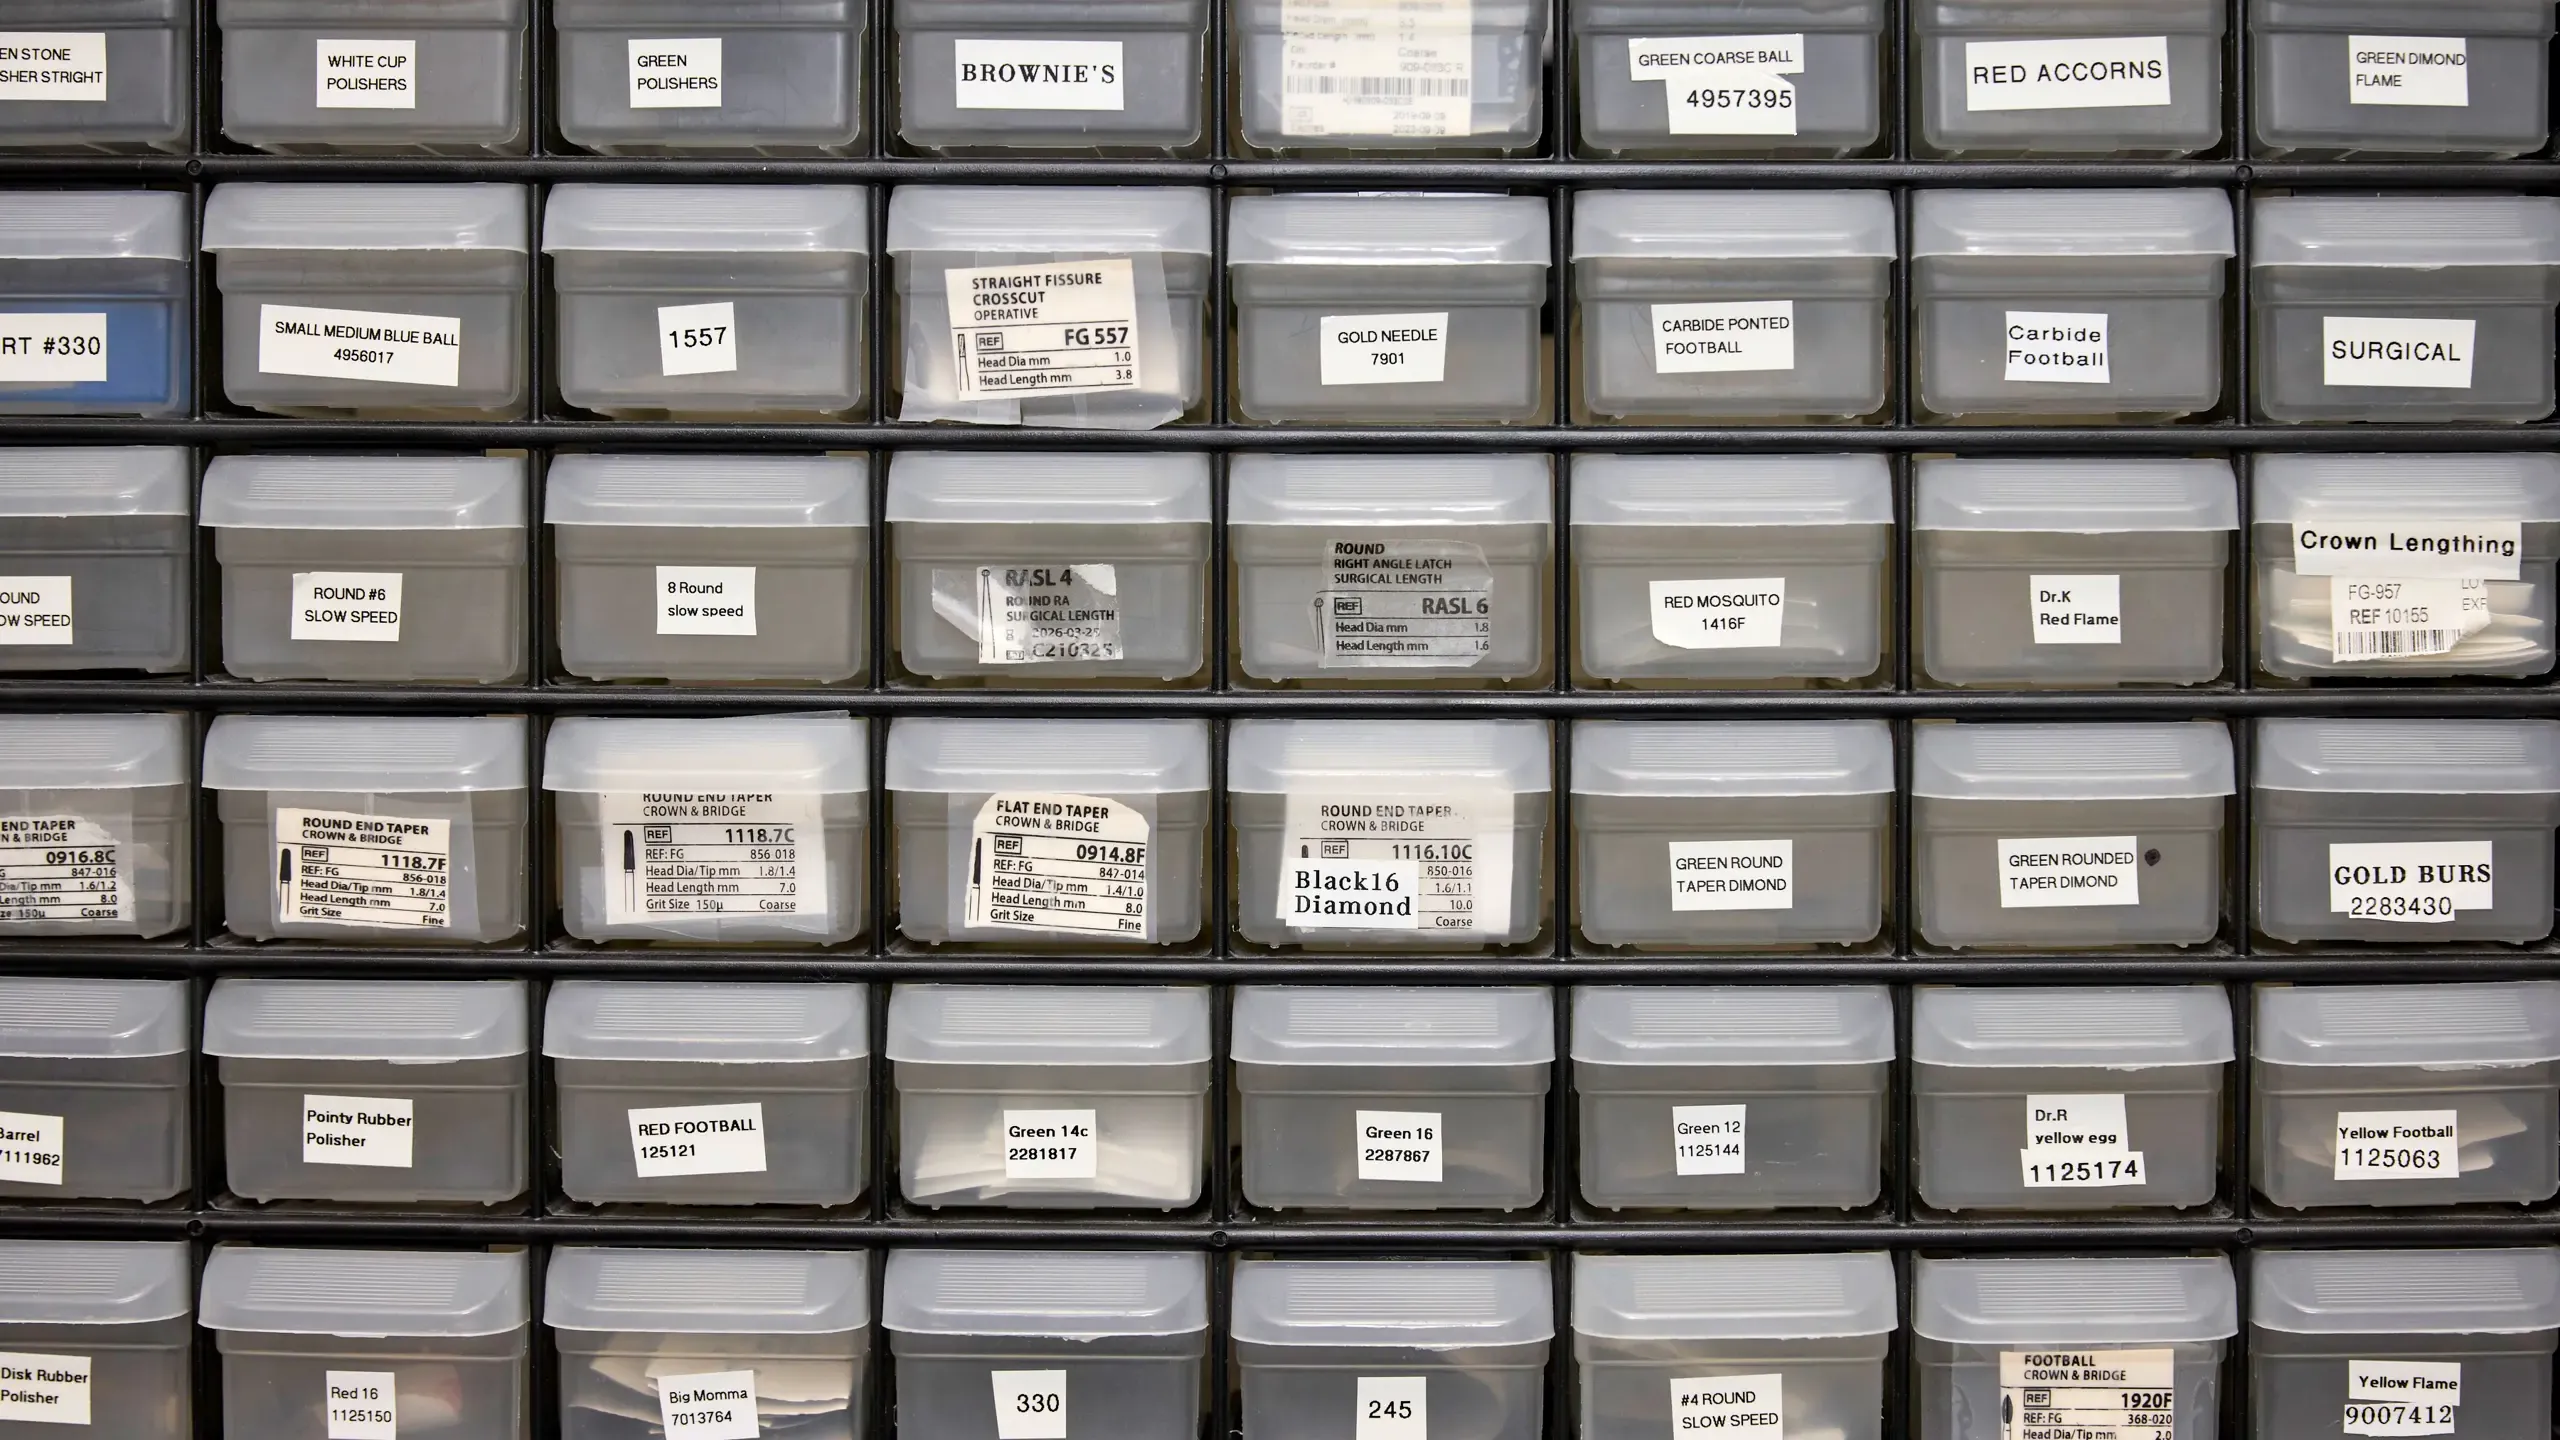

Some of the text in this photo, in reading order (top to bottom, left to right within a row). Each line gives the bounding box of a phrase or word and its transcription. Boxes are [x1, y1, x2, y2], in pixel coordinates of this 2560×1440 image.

[0, 48, 70, 60] EN STONE
[638, 55, 686, 67] GREEN
[1639, 51, 1793, 66] GREEN COARSE BALL
[2357, 52, 2466, 66] GREEN DIMOND
[328, 56, 406, 67] WHITE CUP
[0, 70, 103, 83] SHER STRIGHT
[962, 64, 1114, 83] BROWNIE'S
[1974, 60, 2161, 84] RED ACCORNS
[328, 78, 406, 90] POLISHERS
[638, 77, 717, 89] POLISHERS
[2357, 74, 2401, 86] FLAME
[1687, 89, 1791, 108] 4957395
[973, 273, 1101, 289] STRAIGHT FISSURE
[974, 292, 1045, 306] CROSSCUT
[975, 308, 1037, 320] OPERATIVE
[1663, 317, 1789, 332] CARBIDE PONTED
[276, 322, 458, 346] SMALL MEDIUM BLUE BALL
[670, 327, 726, 348] 1557
[1065, 327, 1128, 345] FG 557
[1338, 329, 1437, 343] GOLD NEEDLE
[2009, 325, 2100, 342] Carbide
[3, 336, 100, 355] RT #330
[979, 337, 999, 346] REF
[1666, 342, 1742, 354] FOOTBALL
[334, 349, 393, 363] 4956017
[1115, 352, 1131, 361] 1.0
[2333, 340, 2460, 361] SURGICAL
[978, 356, 1006, 367] Head
[1009, 356, 1026, 366] Dia
[1372, 353, 1403, 365] 7901
[2009, 350, 2102, 366] Football
[980, 374, 1007, 385] Head
[1010, 373, 1047, 386] Length
[1116, 370, 1132, 379] 3.8
[1335, 543, 1384, 555] ROUND
[2301, 530, 2514, 556] Crown Lengthing
[1335, 559, 1451, 569] RIGHT ANGLE LATCH
[1060, 569, 1072, 585] 4
[314, 588, 385, 600] ROUND #6
[668, 582, 722, 593] 8 Round
[2349, 584, 2401, 599] FG-957
[0, 592, 40, 604] OUND
[1665, 594, 1779, 608] RED MOSQUITO
[2041, 591, 2070, 602] Dr.K
[668, 605, 743, 617] slow speed
[1423, 598, 1488, 614] RASL 6
[0, 615, 70, 626] OW SPEED
[305, 610, 397, 623] SLOW SPEED
[2041, 613, 2118, 625] Red Flame
[2351, 607, 2428, 624] REF 10155
[1703, 618, 1745, 630] 1416F
[997, 800, 1108, 818] FLAT END TAPER
[2, 820, 75, 831] END TAPER
[303, 818, 428, 835] ROUND END TAPER
[725, 828, 795, 843] 1118.7C
[46, 850, 116, 863] 0916.8C
[1077, 844, 1145, 863] 0914.8F
[1393, 845, 1472, 862] 1116.10C
[2010, 852, 2133, 866] GREEN ROUNDED
[381, 854, 446, 870] 1118.7F
[1676, 856, 1782, 870] GREEN ROUND
[1295, 870, 1398, 891] Black16
[2335, 864, 2490, 885] GOLD BURS
[1677, 879, 1786, 892] TAPER DIMOND
[2010, 875, 2117, 889] TAPER DIMOND
[1295, 895, 1411, 916] Diamond
[2352, 897, 2451, 915] 2283430
[308, 1110, 411, 1126] Pointy Rubber
[2036, 1109, 2067, 1121] Dr.R
[639, 1119, 756, 1136] RED FOOTBALL
[1009, 1125, 1088, 1137] Green 14c
[1366, 1127, 1432, 1139] Green 16
[1678, 1121, 1740, 1134] Green 12
[2339, 1126, 2452, 1139] Yellow Football
[307, 1133, 366, 1146] Polisher
[2036, 1132, 2116, 1144] yellow egg
[641, 1145, 694, 1158] 125121
[1010, 1148, 1076, 1160] 2281817
[1366, 1149, 1429, 1162] 2287867
[1680, 1144, 1739, 1157] 1125144
[2342, 1148, 2439, 1169] 1125063
[2031, 1160, 2137, 1182] 1125174
[2025, 1355, 2095, 1366] FOOTBALL
[2, 1367, 87, 1383] Disk Rubber
[2359, 1376, 2457, 1389] Yellow Flame
[1, 1390, 58, 1404] Polisher
[332, 1387, 378, 1399] Red 16
[670, 1390, 747, 1403] Big Momma
[1681, 1391, 1755, 1406] #4 ROUND
[1017, 1394, 1059, 1412] 330
[2122, 1393, 2172, 1408] 1920F
[333, 1410, 391, 1422] 1125150
[1369, 1401, 1411, 1419] 245
[2346, 1405, 2451, 1424] 9007412
[672, 1411, 732, 1425] 7013764
[1683, 1413, 1778, 1428] SLOW SPEED
